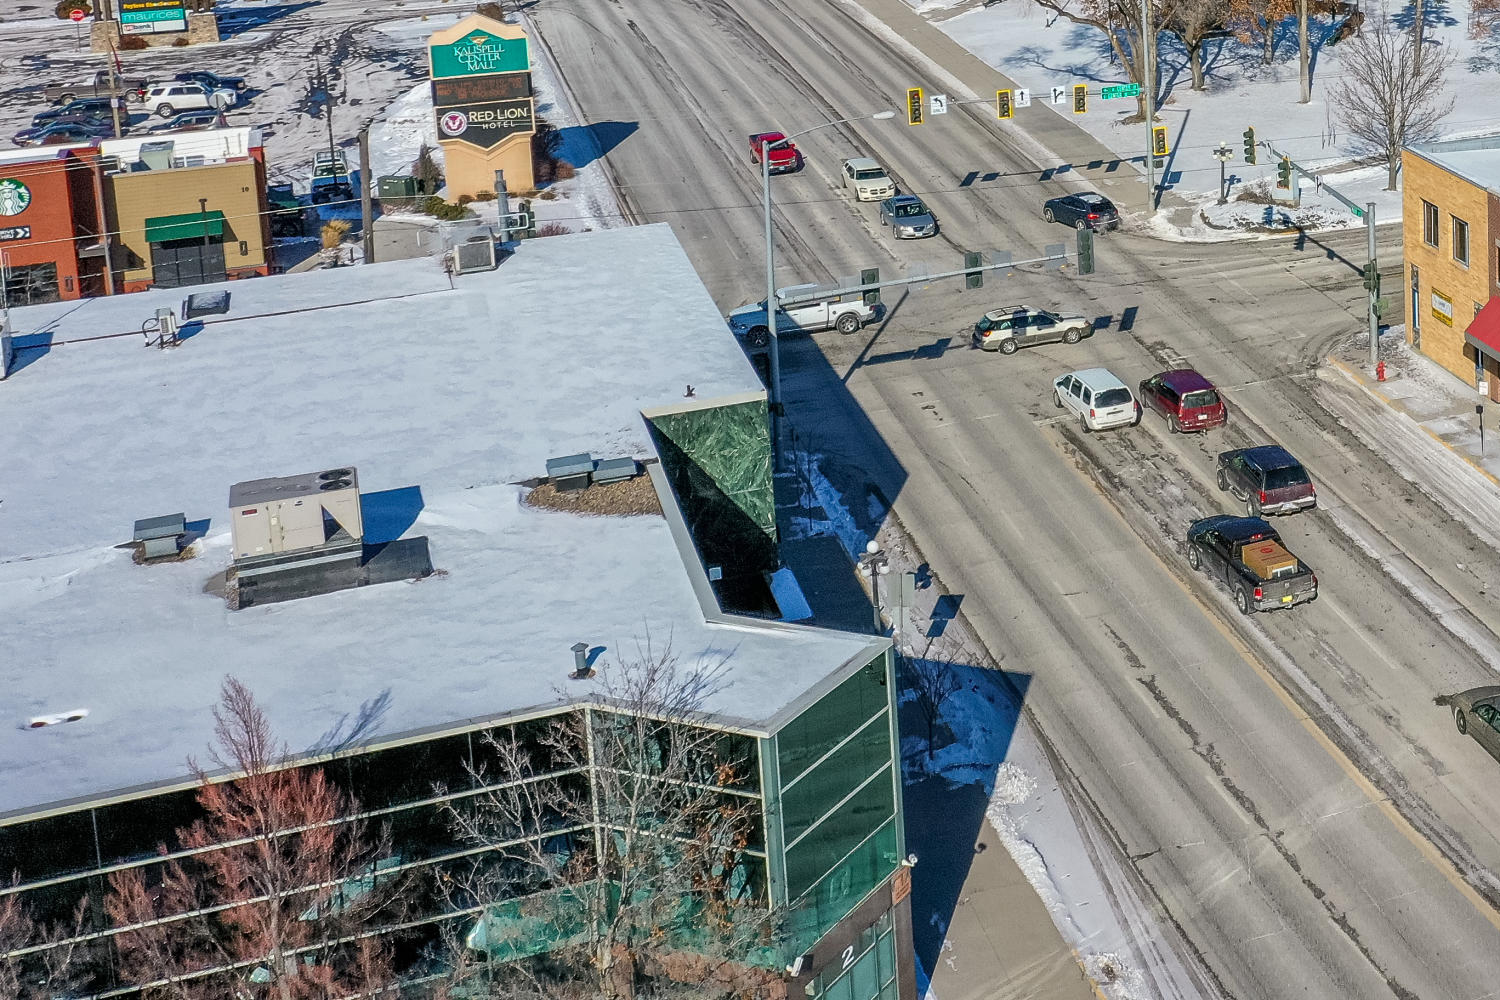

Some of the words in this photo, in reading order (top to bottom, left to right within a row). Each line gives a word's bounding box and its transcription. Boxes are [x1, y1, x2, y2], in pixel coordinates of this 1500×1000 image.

[124, 10, 180, 21] maurices
[454, 43, 504, 56] KALISPELL
[458, 53, 500, 64] CENTER
[467, 61, 496, 71] MALL
[469, 110, 493, 122] RED
[497, 108, 528, 120] LION
[482, 121, 515, 129] HOTEL
[842, 945, 855, 969] 2
